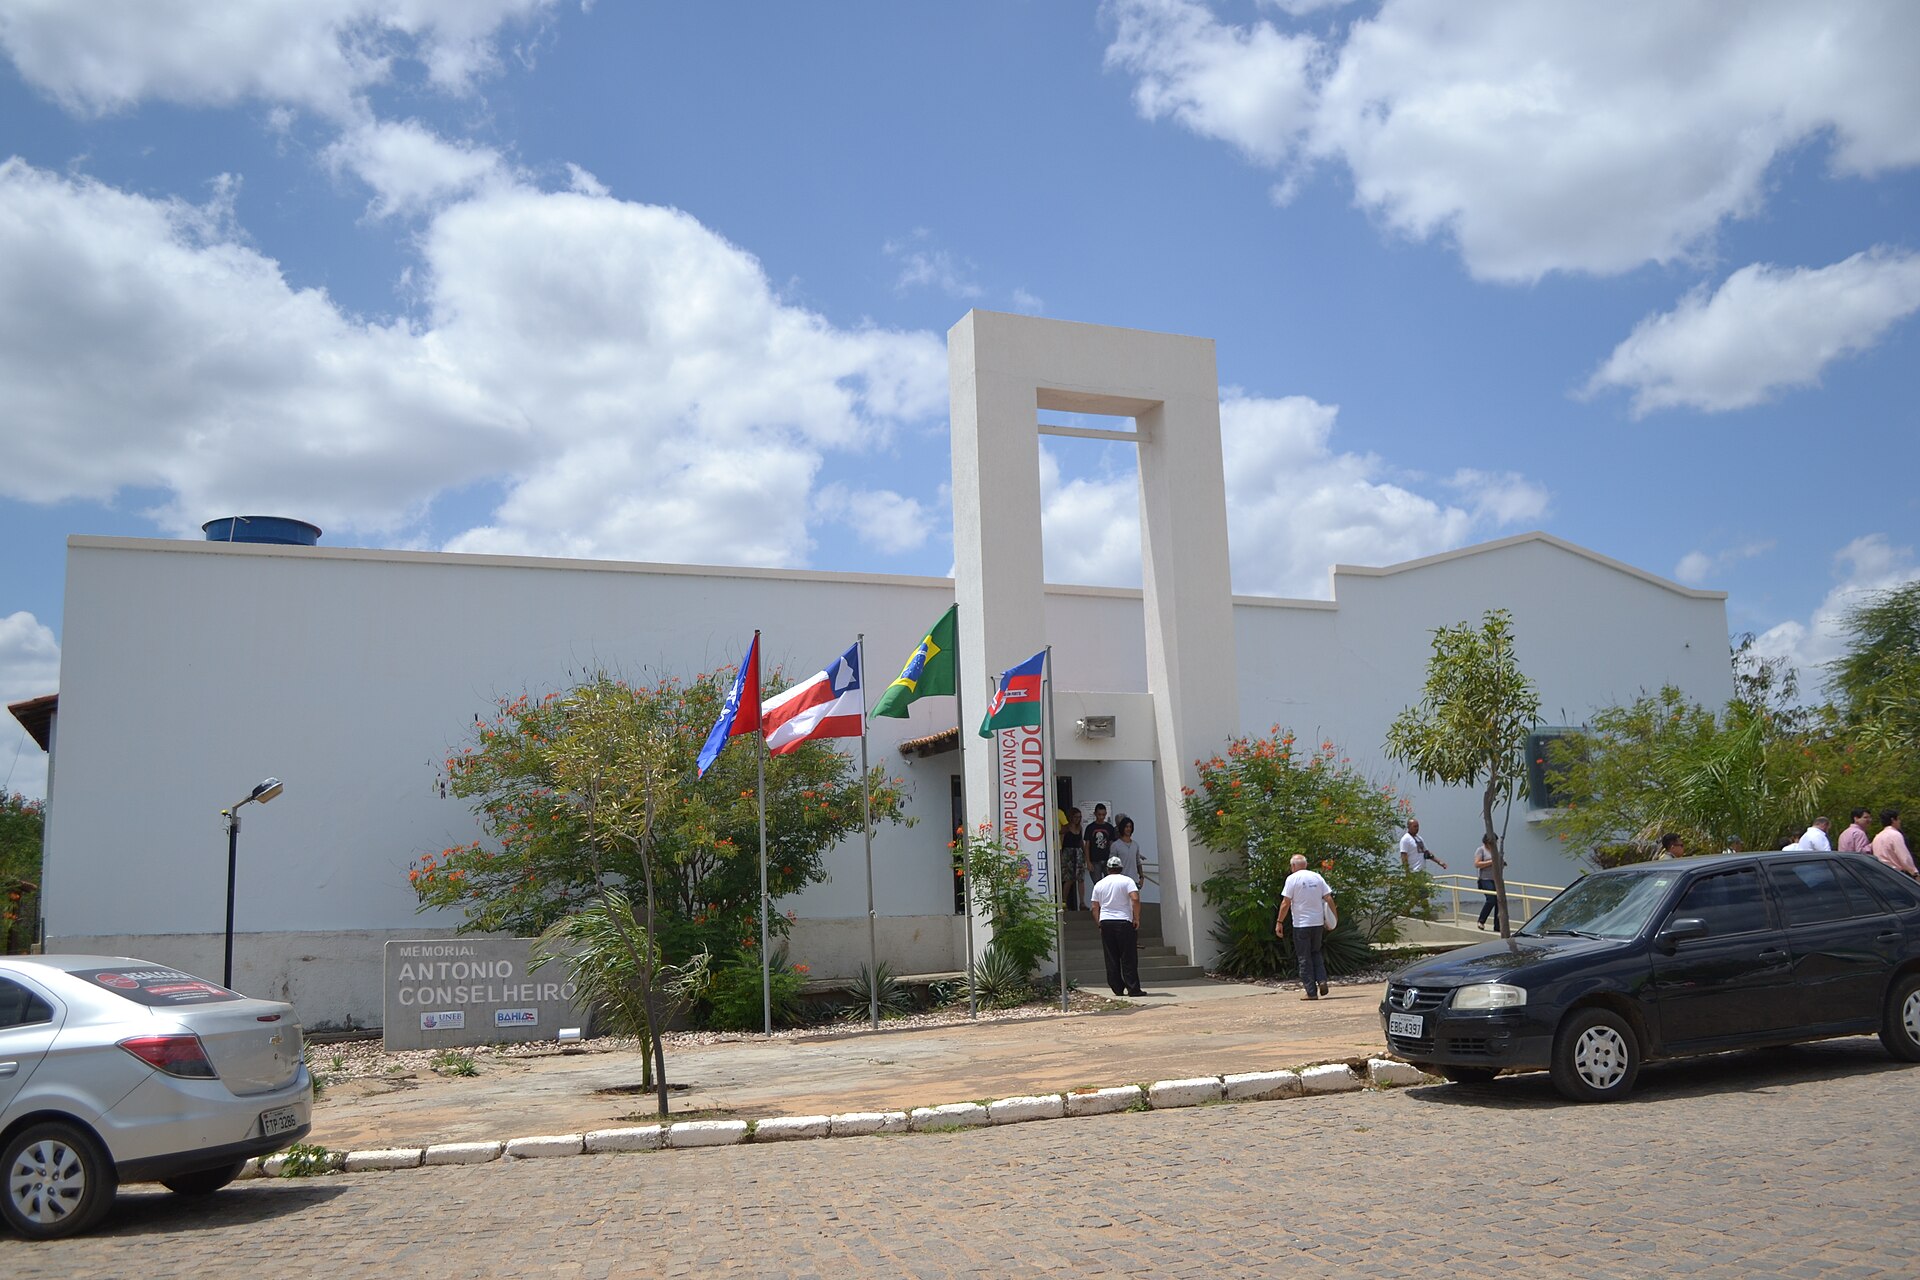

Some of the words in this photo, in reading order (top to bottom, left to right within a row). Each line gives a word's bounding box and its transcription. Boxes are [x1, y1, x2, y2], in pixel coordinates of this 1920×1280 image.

[1004, 791, 1019, 852] CAMPUS
[1037, 850, 1048, 895] UNEB
[400, 945, 478, 957] MEMORIAL
[398, 960, 513, 981] ANTONIO
[398, 982, 577, 1006] CONSELHEIRO
[439, 1012, 462, 1020] UNEB
[497, 1012, 528, 1021] BAHIA
